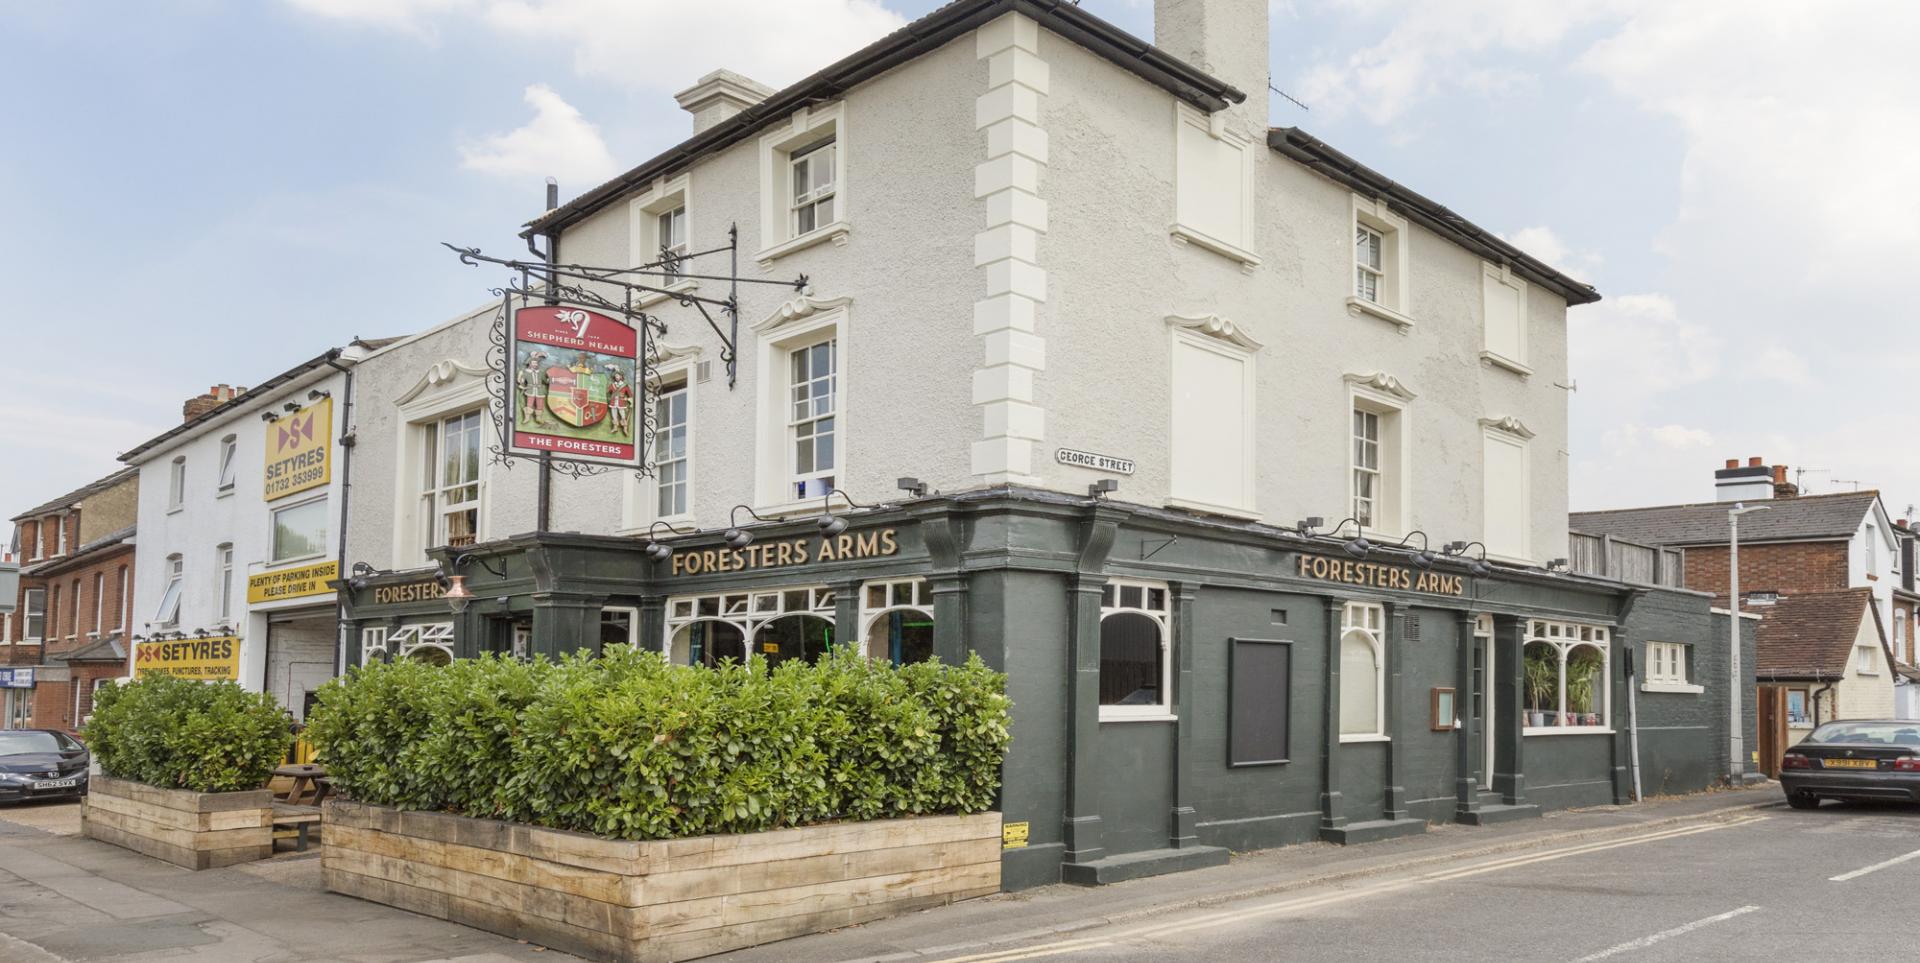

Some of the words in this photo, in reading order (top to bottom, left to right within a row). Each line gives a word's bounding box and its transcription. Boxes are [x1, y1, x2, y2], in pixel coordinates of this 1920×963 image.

[527, 331, 584, 345] SHEPHERD
[588, 341, 625, 353] NEAME
[528, 436, 552, 447] THE
[557, 440, 621, 454] FORESTERS
[266, 446, 324, 480] SETYRES
[1060, 451, 1096, 465] GEORGE
[1099, 457, 1133, 472] STREET
[265, 477, 290, 495] 01732
[292, 465, 324, 487] 353999
[672, 539, 808, 577] FORESTERS
[817, 528, 898, 562] ARMS
[250, 575, 271, 587] PLENTY
[272, 574, 281, 584] OF
[282, 569, 310, 582] PARKING
[312, 564, 336, 577] INSIDE
[1300, 554, 1411, 590] FORESTERS
[1415, 570, 1463, 596] ARMS
[263, 585, 286, 597] PLEASE
[288, 582, 307, 594] DRIVE
[308, 580, 316, 591] IN
[162, 639, 232, 661] SETYRES
[204, 665, 231, 675] TRACKING
